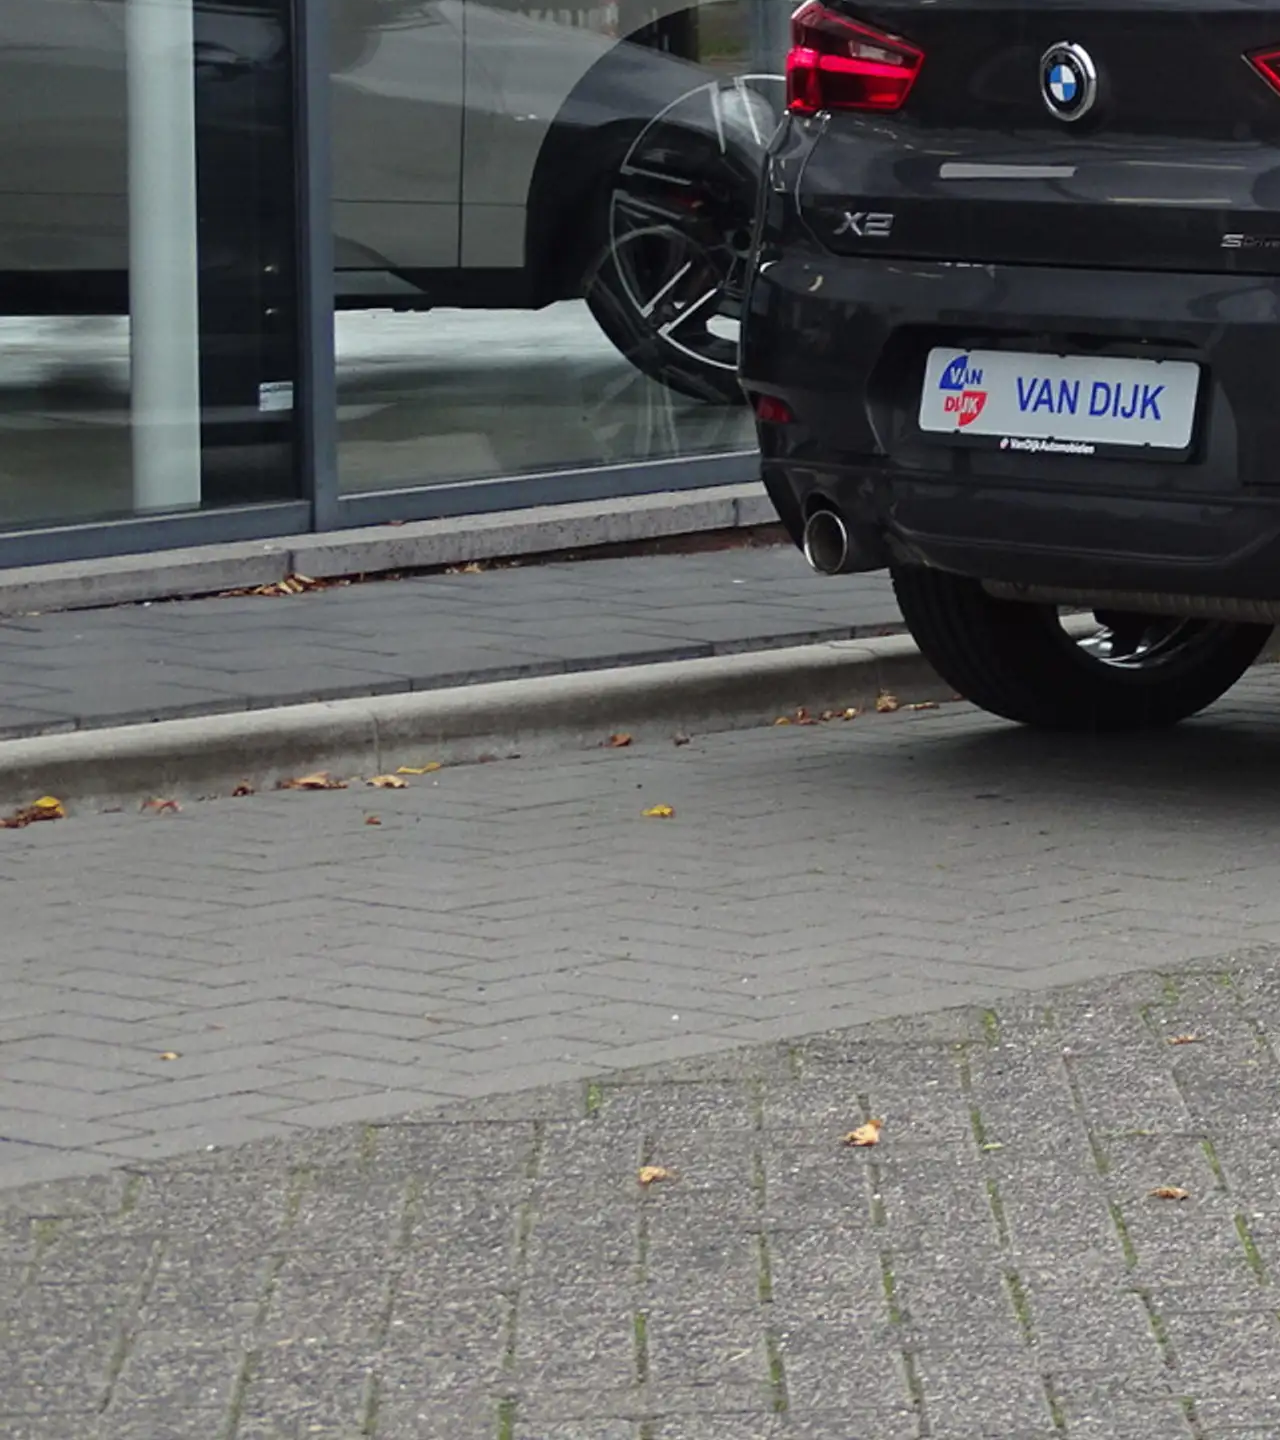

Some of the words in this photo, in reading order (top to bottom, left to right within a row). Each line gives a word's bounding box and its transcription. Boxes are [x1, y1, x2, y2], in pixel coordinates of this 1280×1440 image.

[833, 211, 895, 237] X2
[949, 365, 984, 386] VAN
[1016, 376, 1080, 416] VAN
[1088, 381, 1166, 421] DIJK
